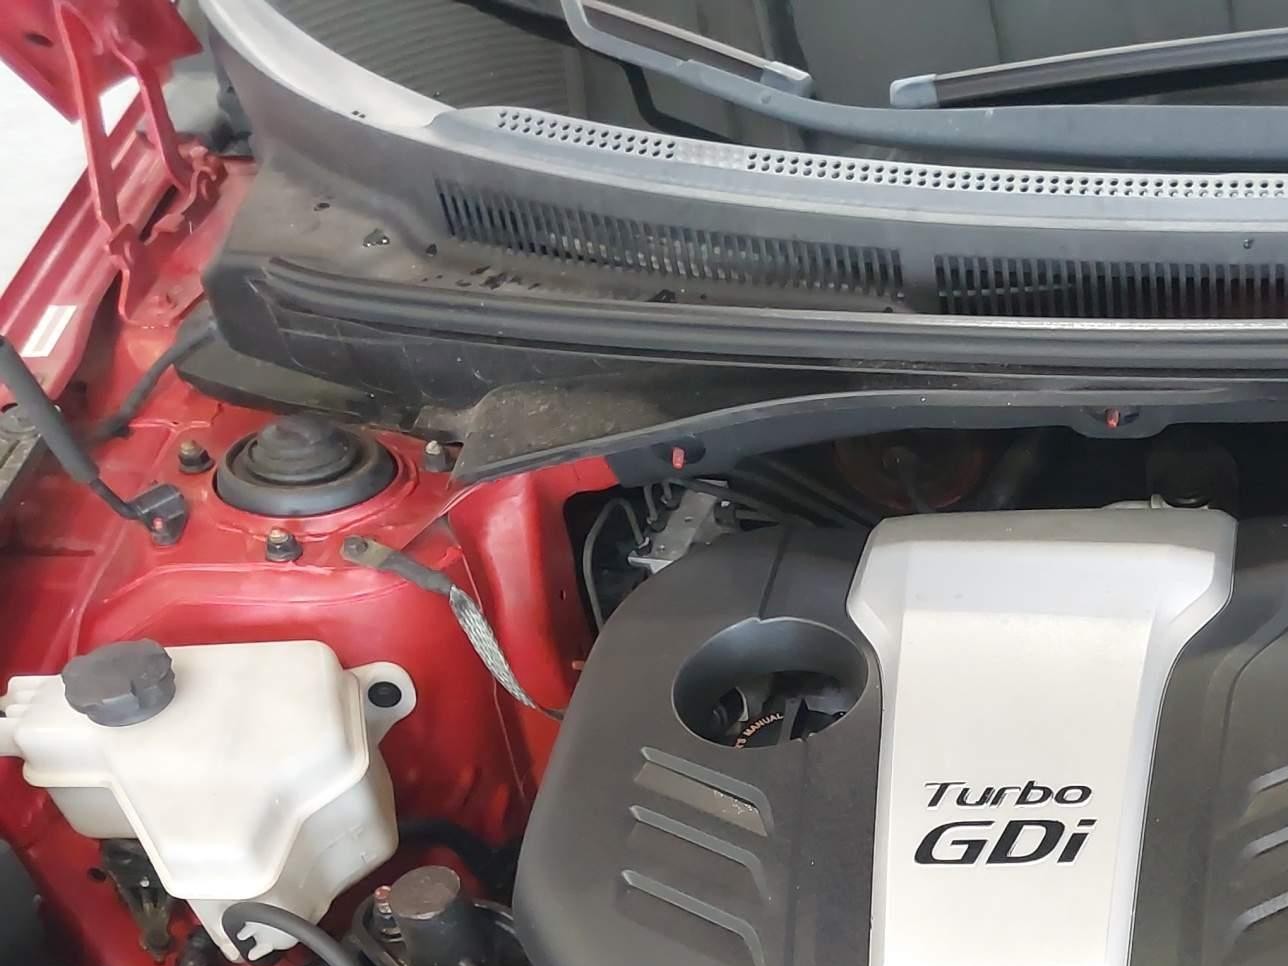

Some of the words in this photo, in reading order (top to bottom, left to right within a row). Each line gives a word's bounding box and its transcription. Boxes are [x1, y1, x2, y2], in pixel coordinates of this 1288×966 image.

[743, 712, 784, 737] MANUAL
[924, 780, 1092, 807] Turbo
[914, 819, 1097, 864] GDi
